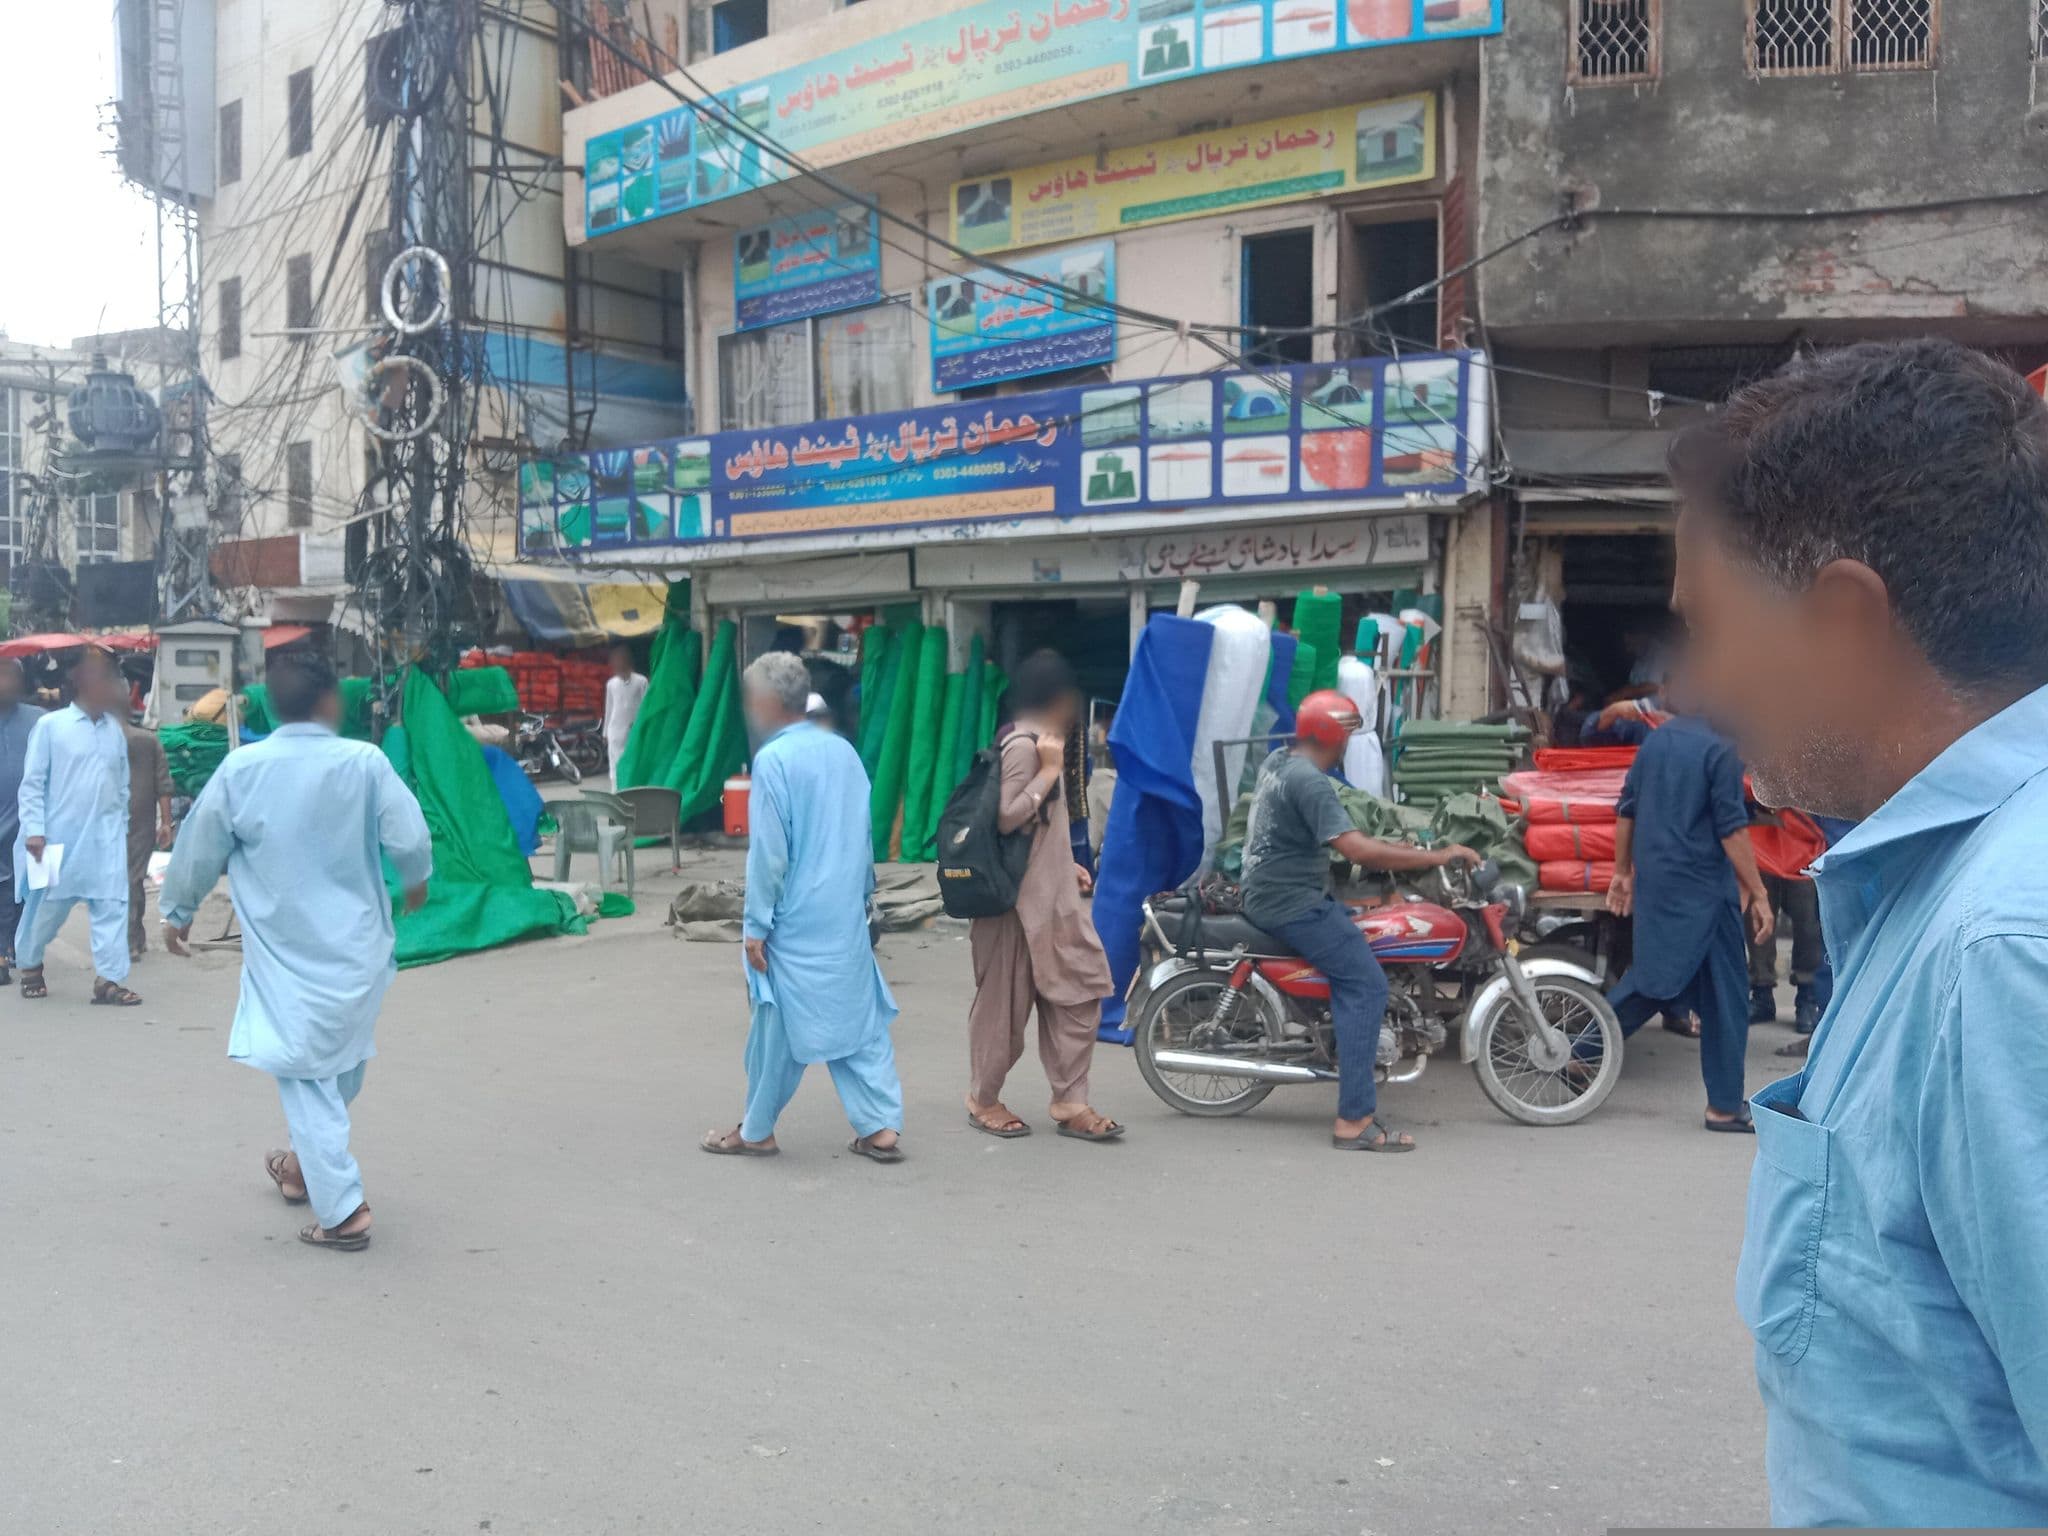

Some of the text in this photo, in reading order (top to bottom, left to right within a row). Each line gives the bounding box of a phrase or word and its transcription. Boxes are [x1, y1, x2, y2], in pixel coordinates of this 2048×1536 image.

[1256, 126, 1336, 161] رحمان
[791, 423, 861, 470] ٹینٹ
[889, 415, 959, 465] ترپال
[962, 410, 1058, 455] رحمان
